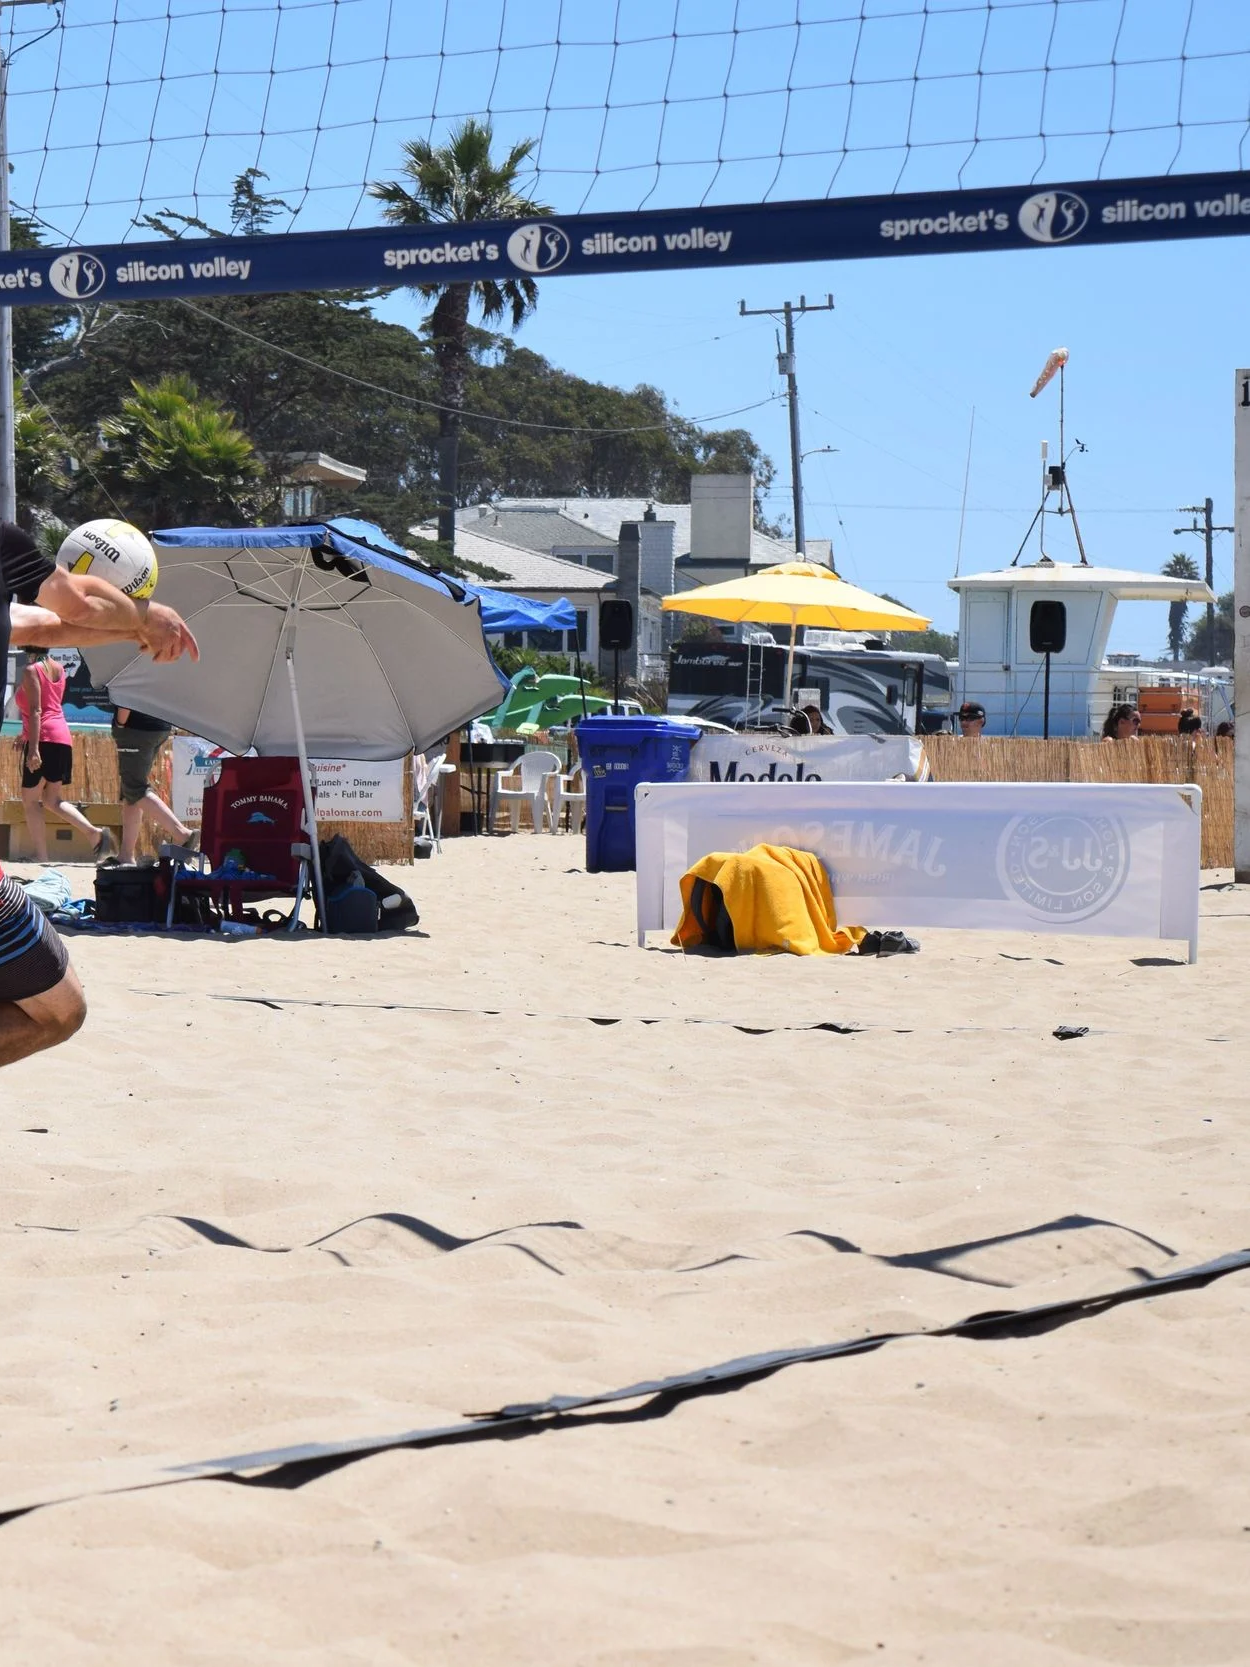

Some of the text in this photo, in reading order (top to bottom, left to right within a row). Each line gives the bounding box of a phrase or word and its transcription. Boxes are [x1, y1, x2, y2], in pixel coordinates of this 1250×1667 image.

[881, 210, 1008, 240] sprocket's
[1103, 200, 1185, 222] silicon
[384, 228, 731, 269] sprocket's silicon volley
[117, 262, 183, 283] silicon
[190, 257, 250, 280] volley
[83, 530, 120, 563] Wilson
[121, 567, 150, 595] Wilson
[745, 744, 788, 758] CERVEZA
[353, 778, 381, 787] Dinner
[230, 795, 289, 810] TOMMY BAHAMA
[341, 790, 357, 798] Full
[359, 790, 373, 798] Bar
[315, 807, 383, 817] lpalomar.com
